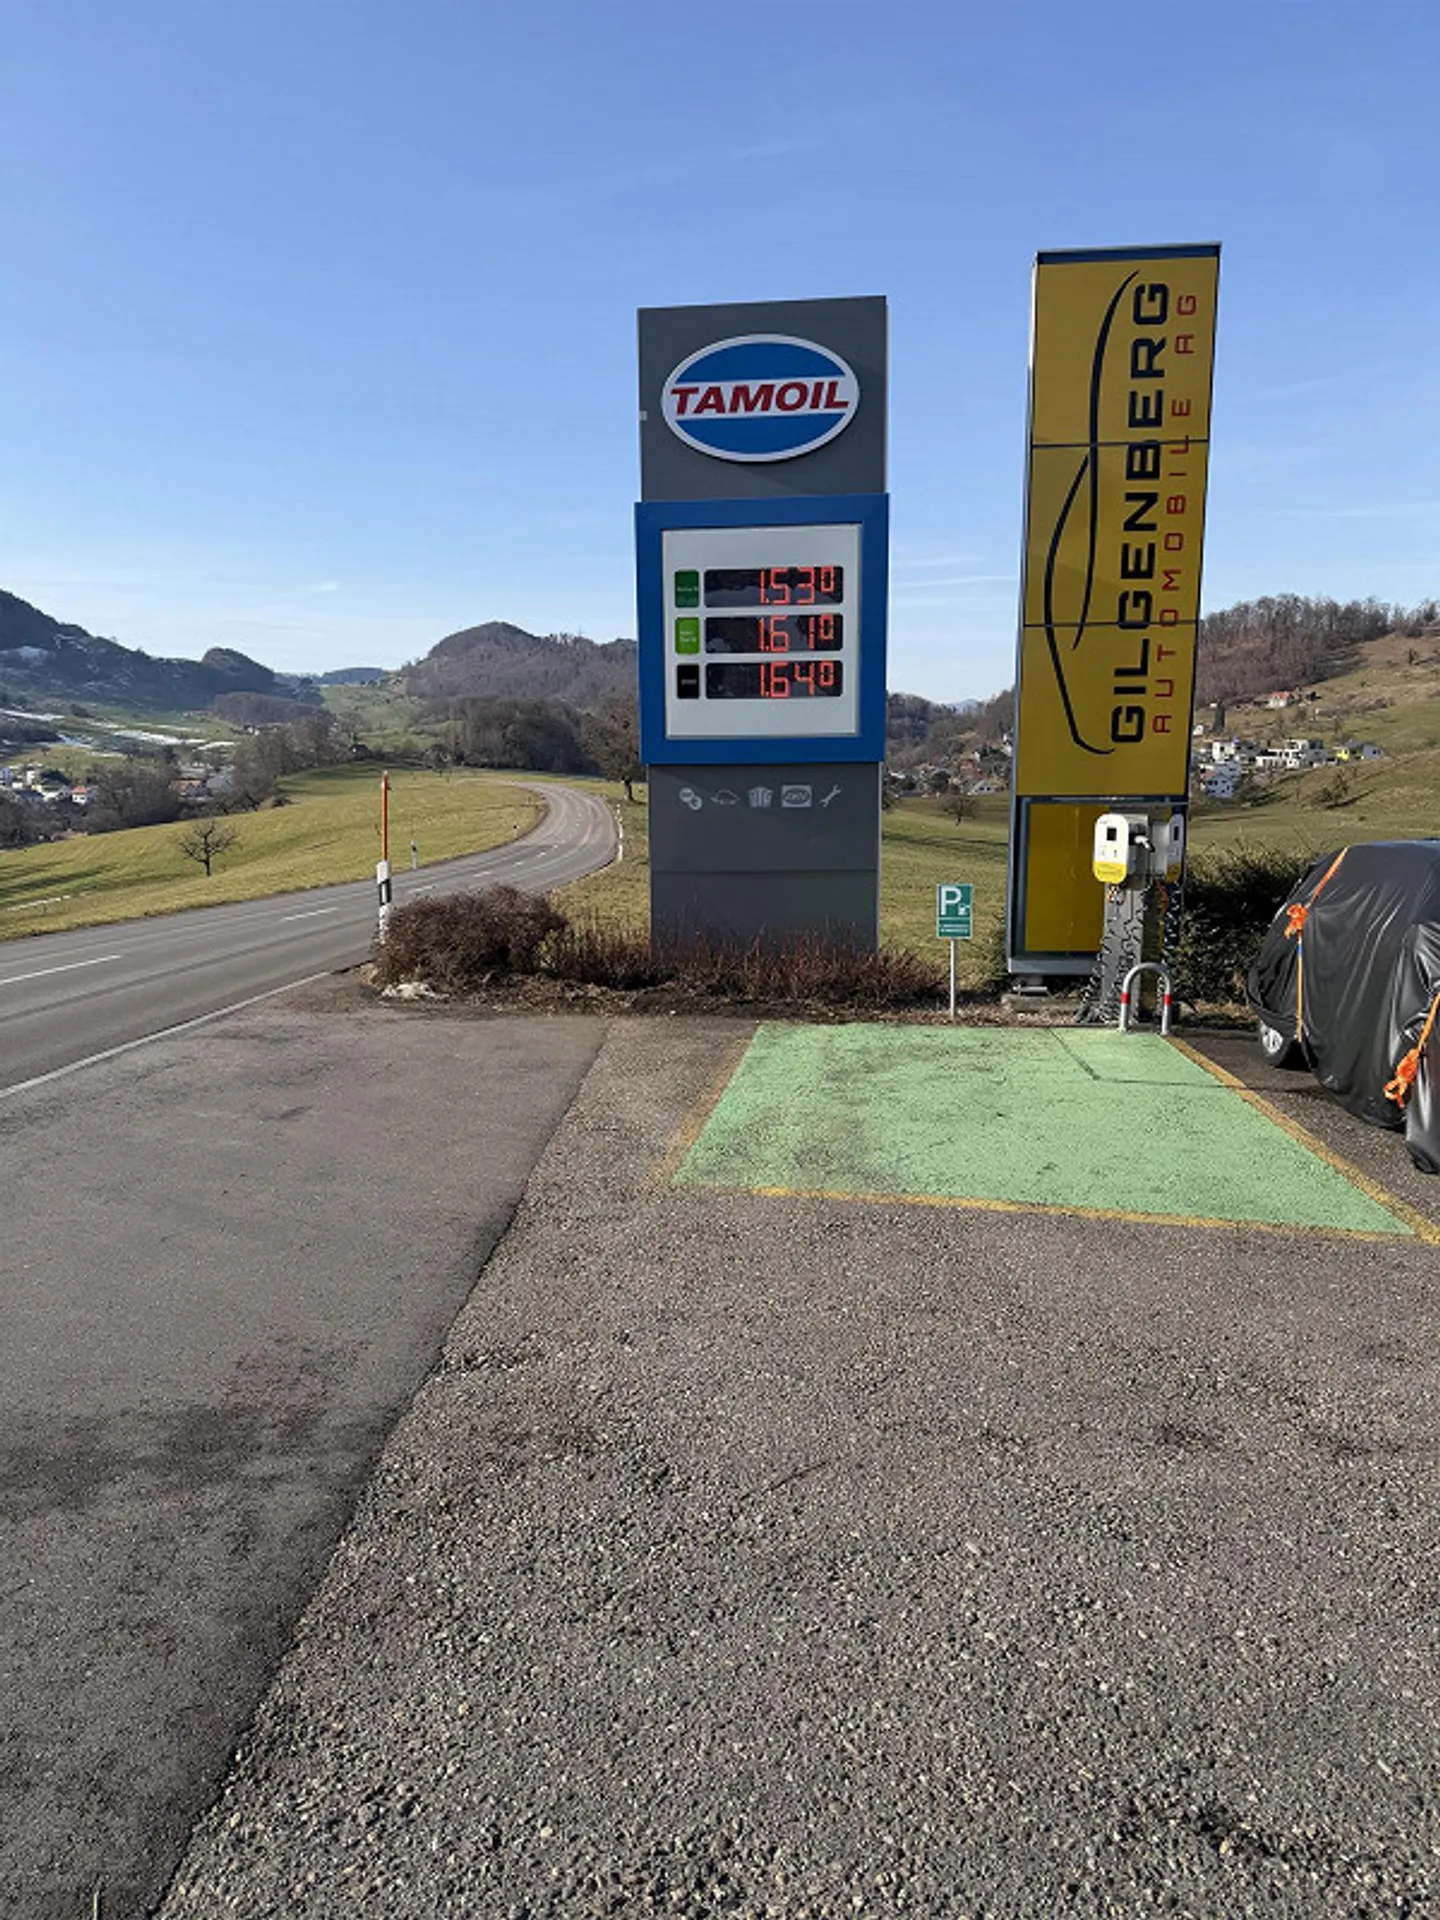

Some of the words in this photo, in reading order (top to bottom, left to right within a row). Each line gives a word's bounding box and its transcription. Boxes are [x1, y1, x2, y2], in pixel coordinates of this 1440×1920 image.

[671, 381, 849, 415] TAMOIL
[1111, 283, 1169, 743] GILGENBERG
[1152, 399, 1192, 733] AUTOMOBILE
[1175, 294, 1197, 355] AG
[941, 886, 962, 915] P
